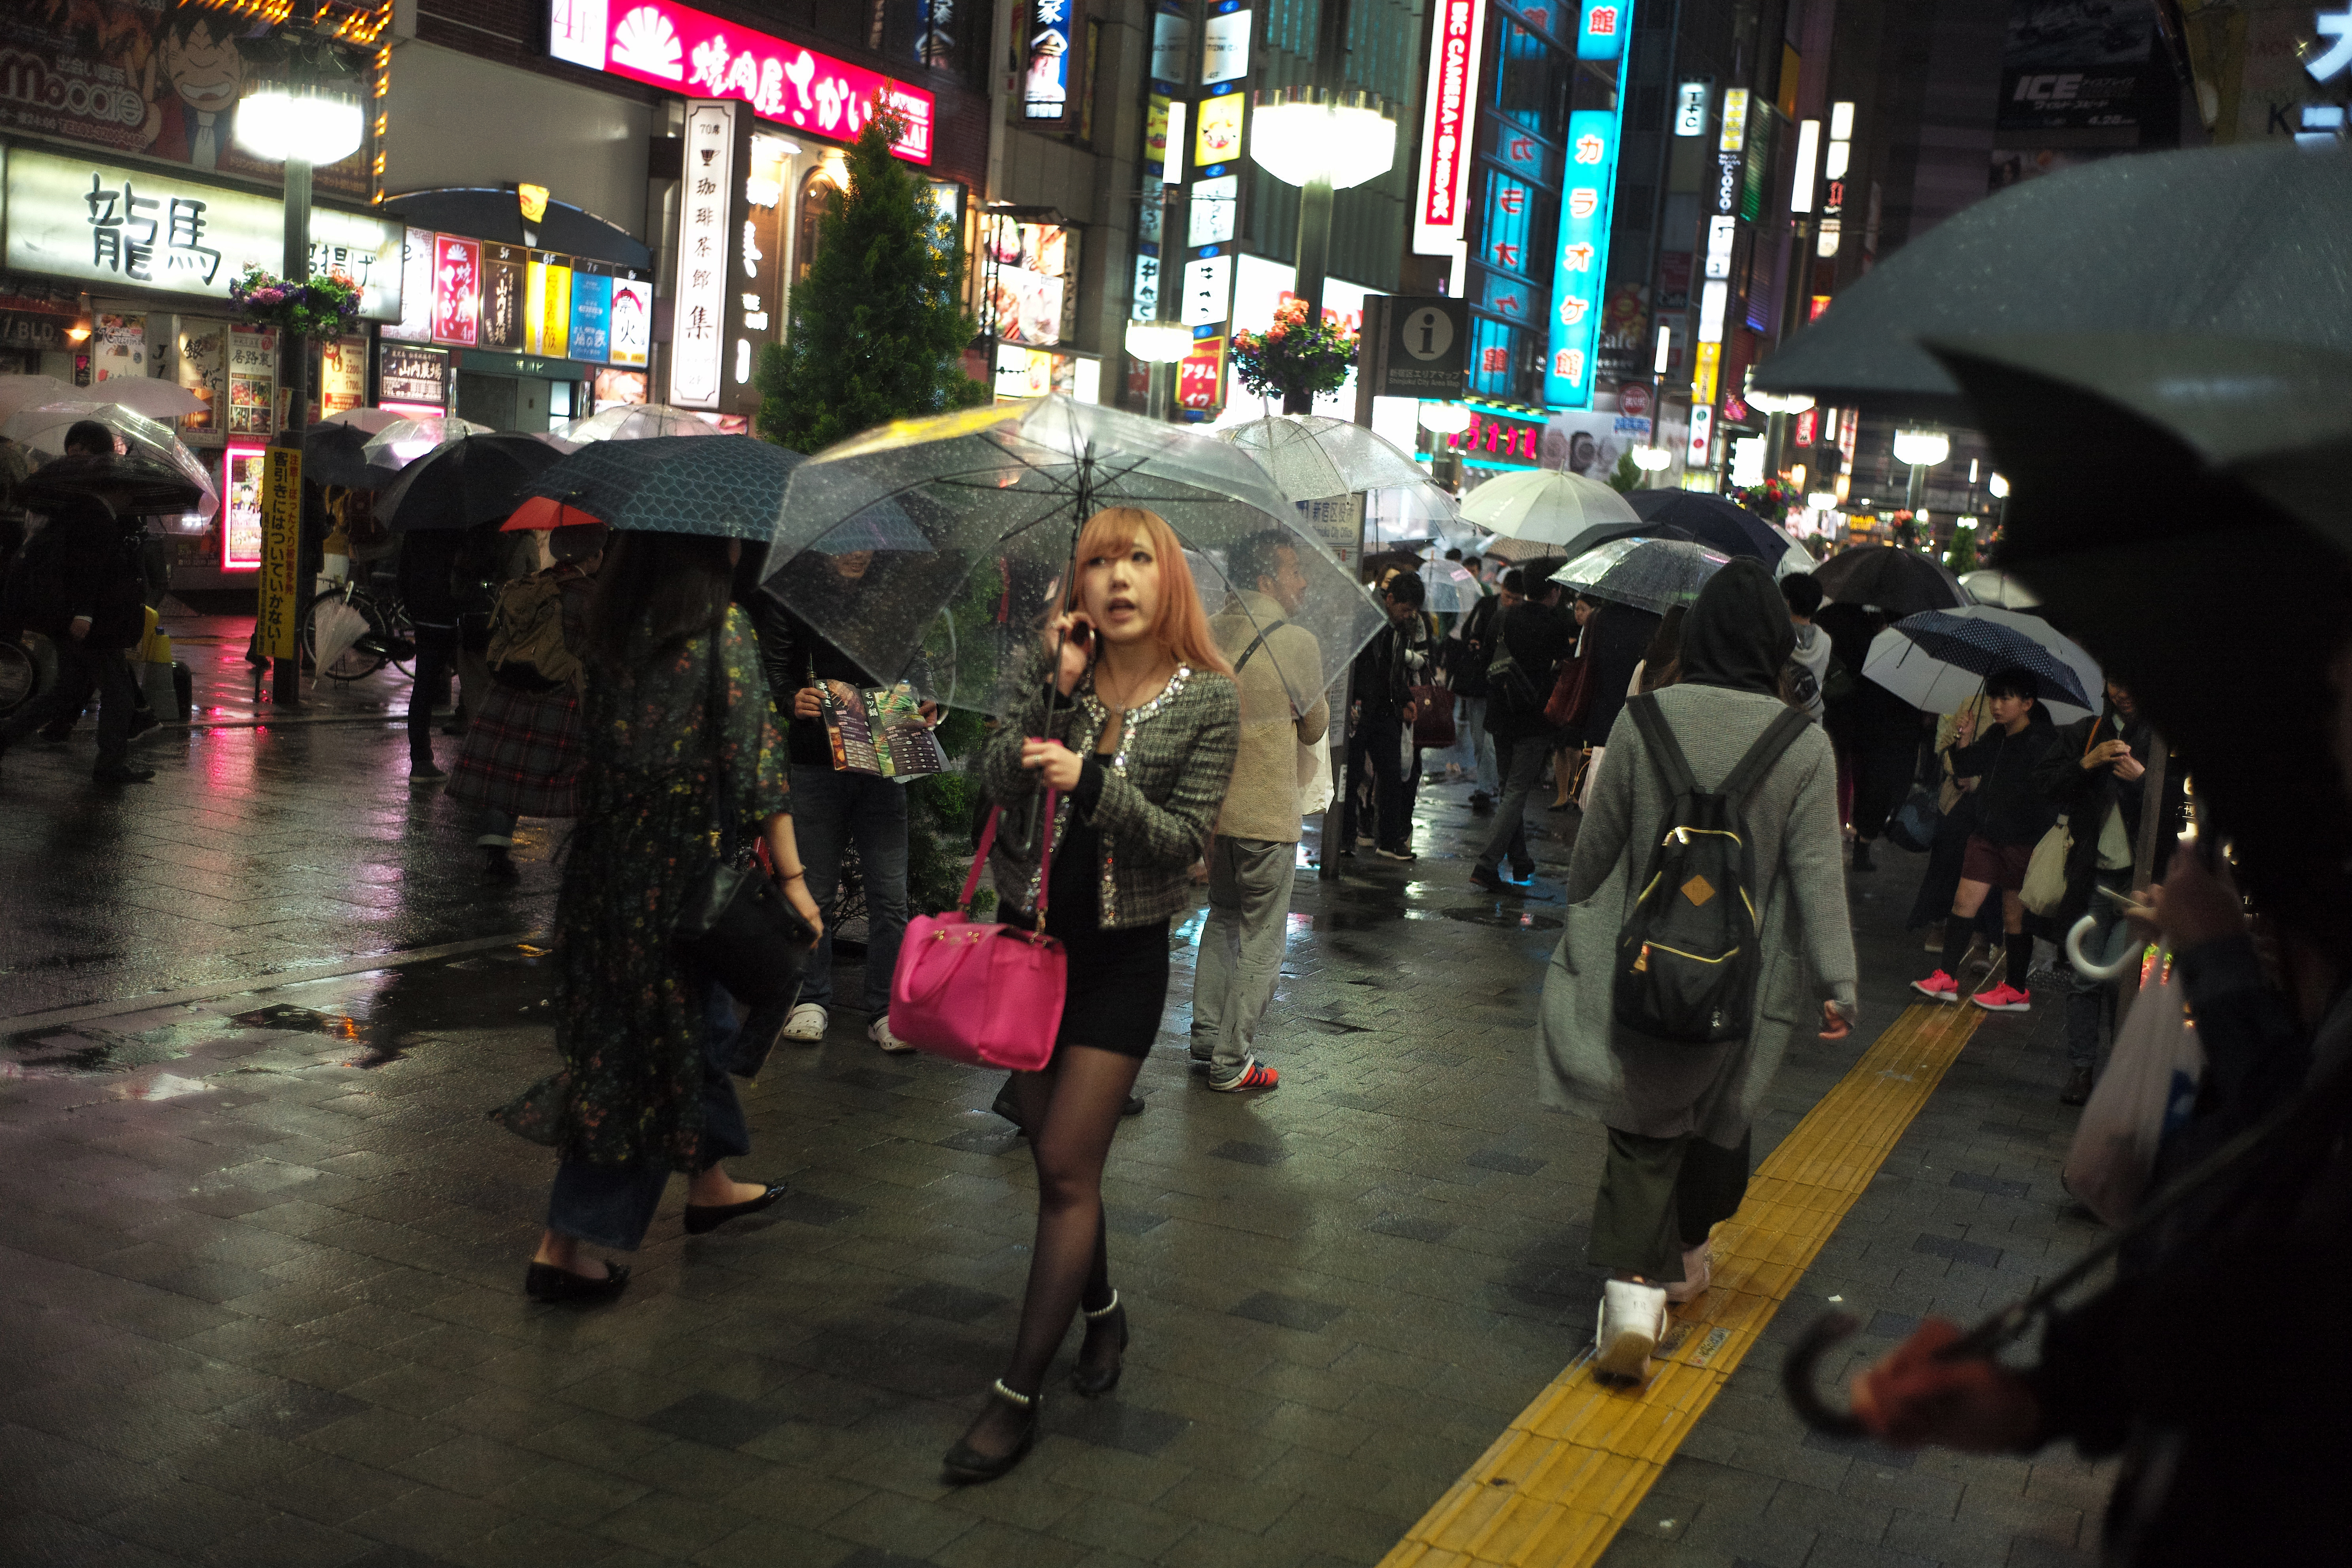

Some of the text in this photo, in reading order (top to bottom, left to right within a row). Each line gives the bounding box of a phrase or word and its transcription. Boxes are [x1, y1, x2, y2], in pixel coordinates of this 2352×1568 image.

[1449, 2, 1469, 36] BIC
[1587, 7, 1619, 36] 館
[690, 36, 872, 131] 焼肉屋さかい
[1441, 39, 1465, 124] CAMERA
[2014, 74, 2084, 100] ICE
[83, 172, 222, 286] 龍馬
[543, 253, 556, 264] 6F
[586, 262, 599, 273] 7F
[1554, 135, 1604, 384] カラオケ館
[439, 265, 456, 337] さかい
[865, 692, 878, 717] モツ鍋
